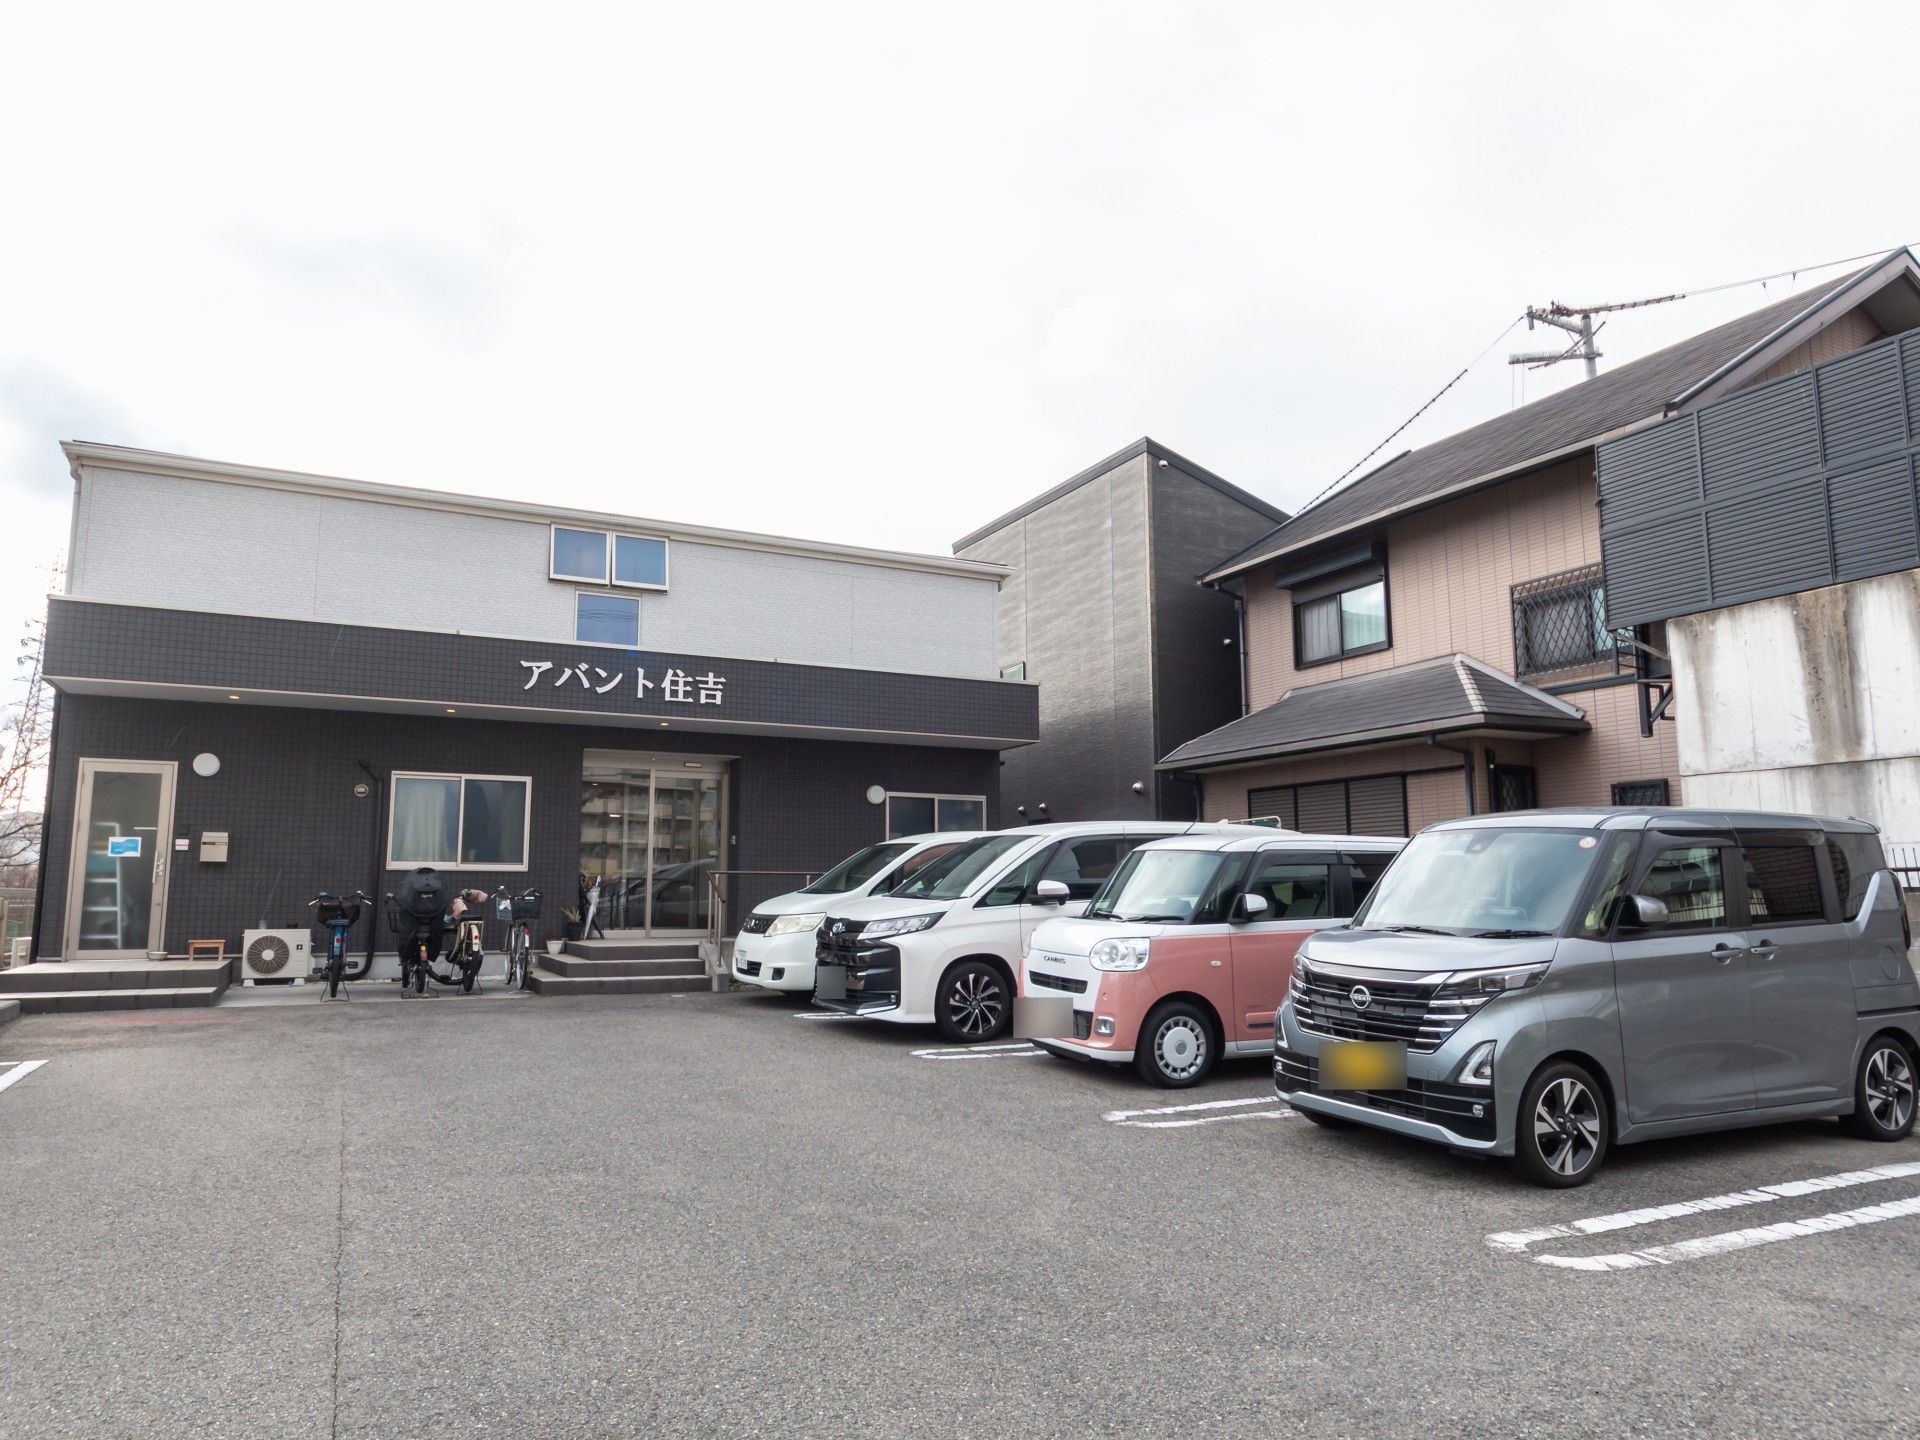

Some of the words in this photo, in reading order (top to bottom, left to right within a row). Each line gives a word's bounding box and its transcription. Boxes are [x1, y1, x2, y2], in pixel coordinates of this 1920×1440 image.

[520, 660, 726, 705] アバント住吉
